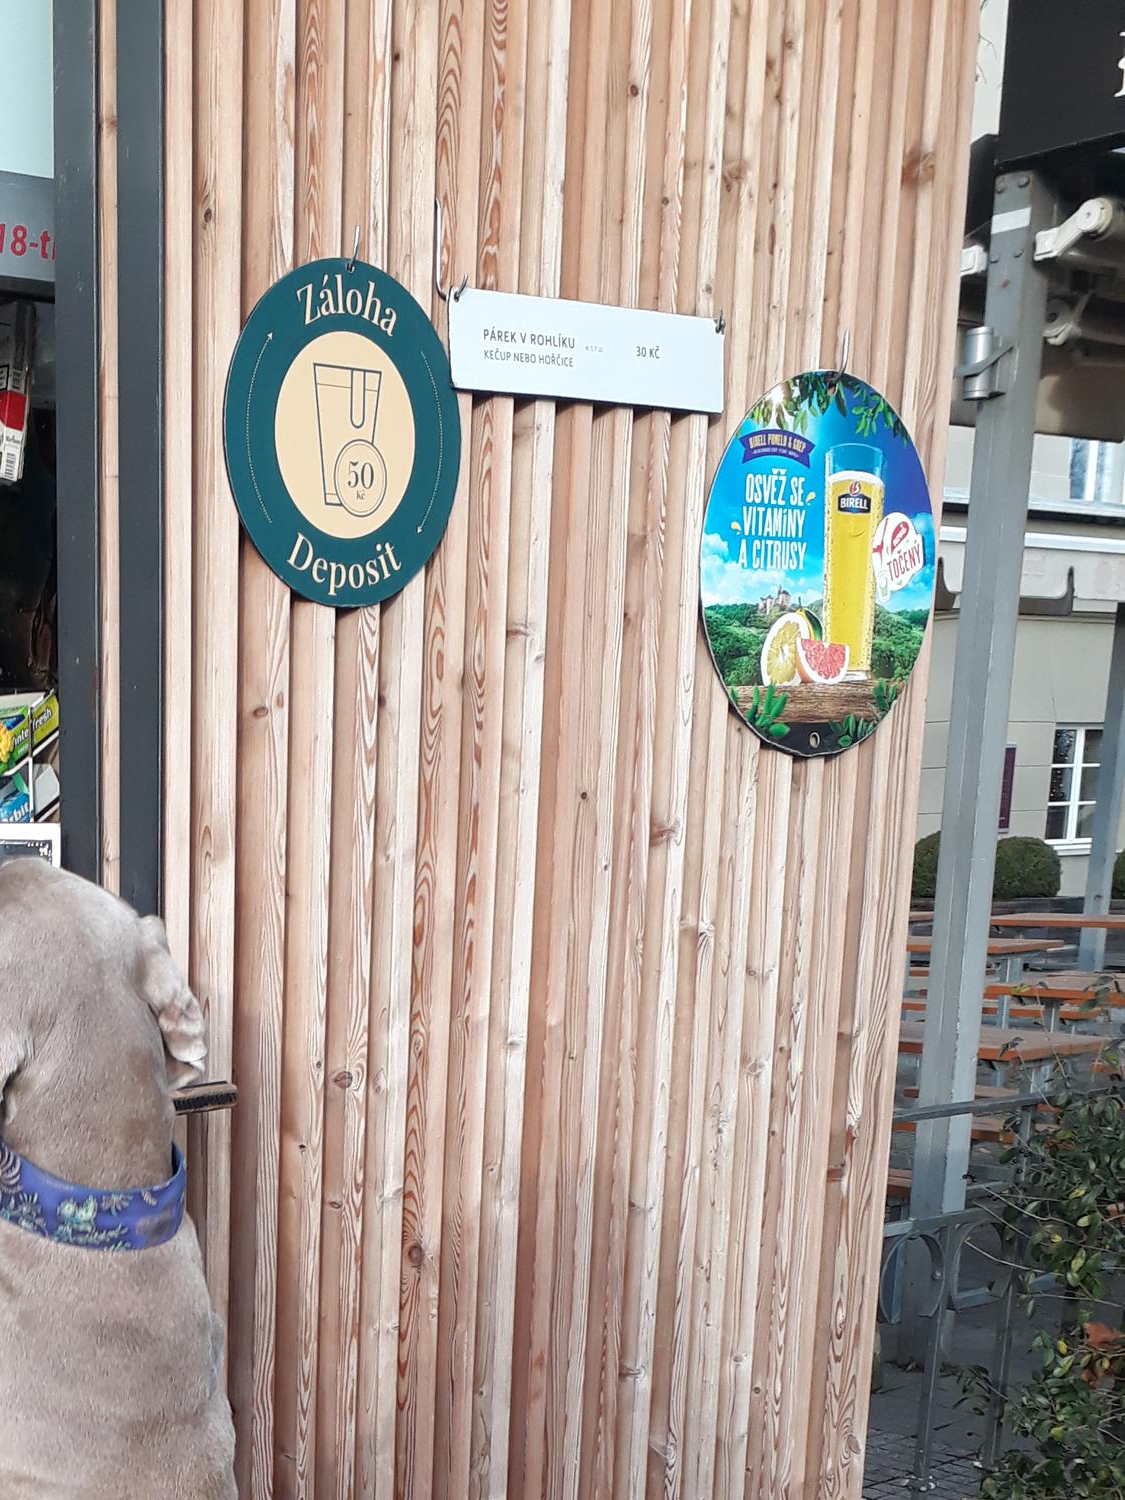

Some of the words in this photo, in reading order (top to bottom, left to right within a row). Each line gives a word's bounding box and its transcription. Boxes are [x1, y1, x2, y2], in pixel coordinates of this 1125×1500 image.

[296, 274, 398, 338] Záloha
[483, 326, 517, 344] PÁREK
[520, 333, 527, 345] V
[530, 334, 576, 349] ROHLÍKU
[636, 346, 647, 357] 30
[649, 345, 661, 359] KČ
[483, 348, 512, 361] KEČUP
[513, 351, 537, 364] NEBO
[538, 353, 575, 368] HOŘČICE
[347, 461, 376, 491] 50
[745, 468, 786, 506] OSVĚŽ
[790, 477, 806, 506] SE
[840, 497, 868, 511] BIRELL
[742, 506, 806, 538] VITAMÍNY
[286, 531, 403, 596] Deposit
[738, 542, 748, 569] A
[752, 540, 807, 570] CITRUSY
[886, 539, 921, 581] TOČENÝ
